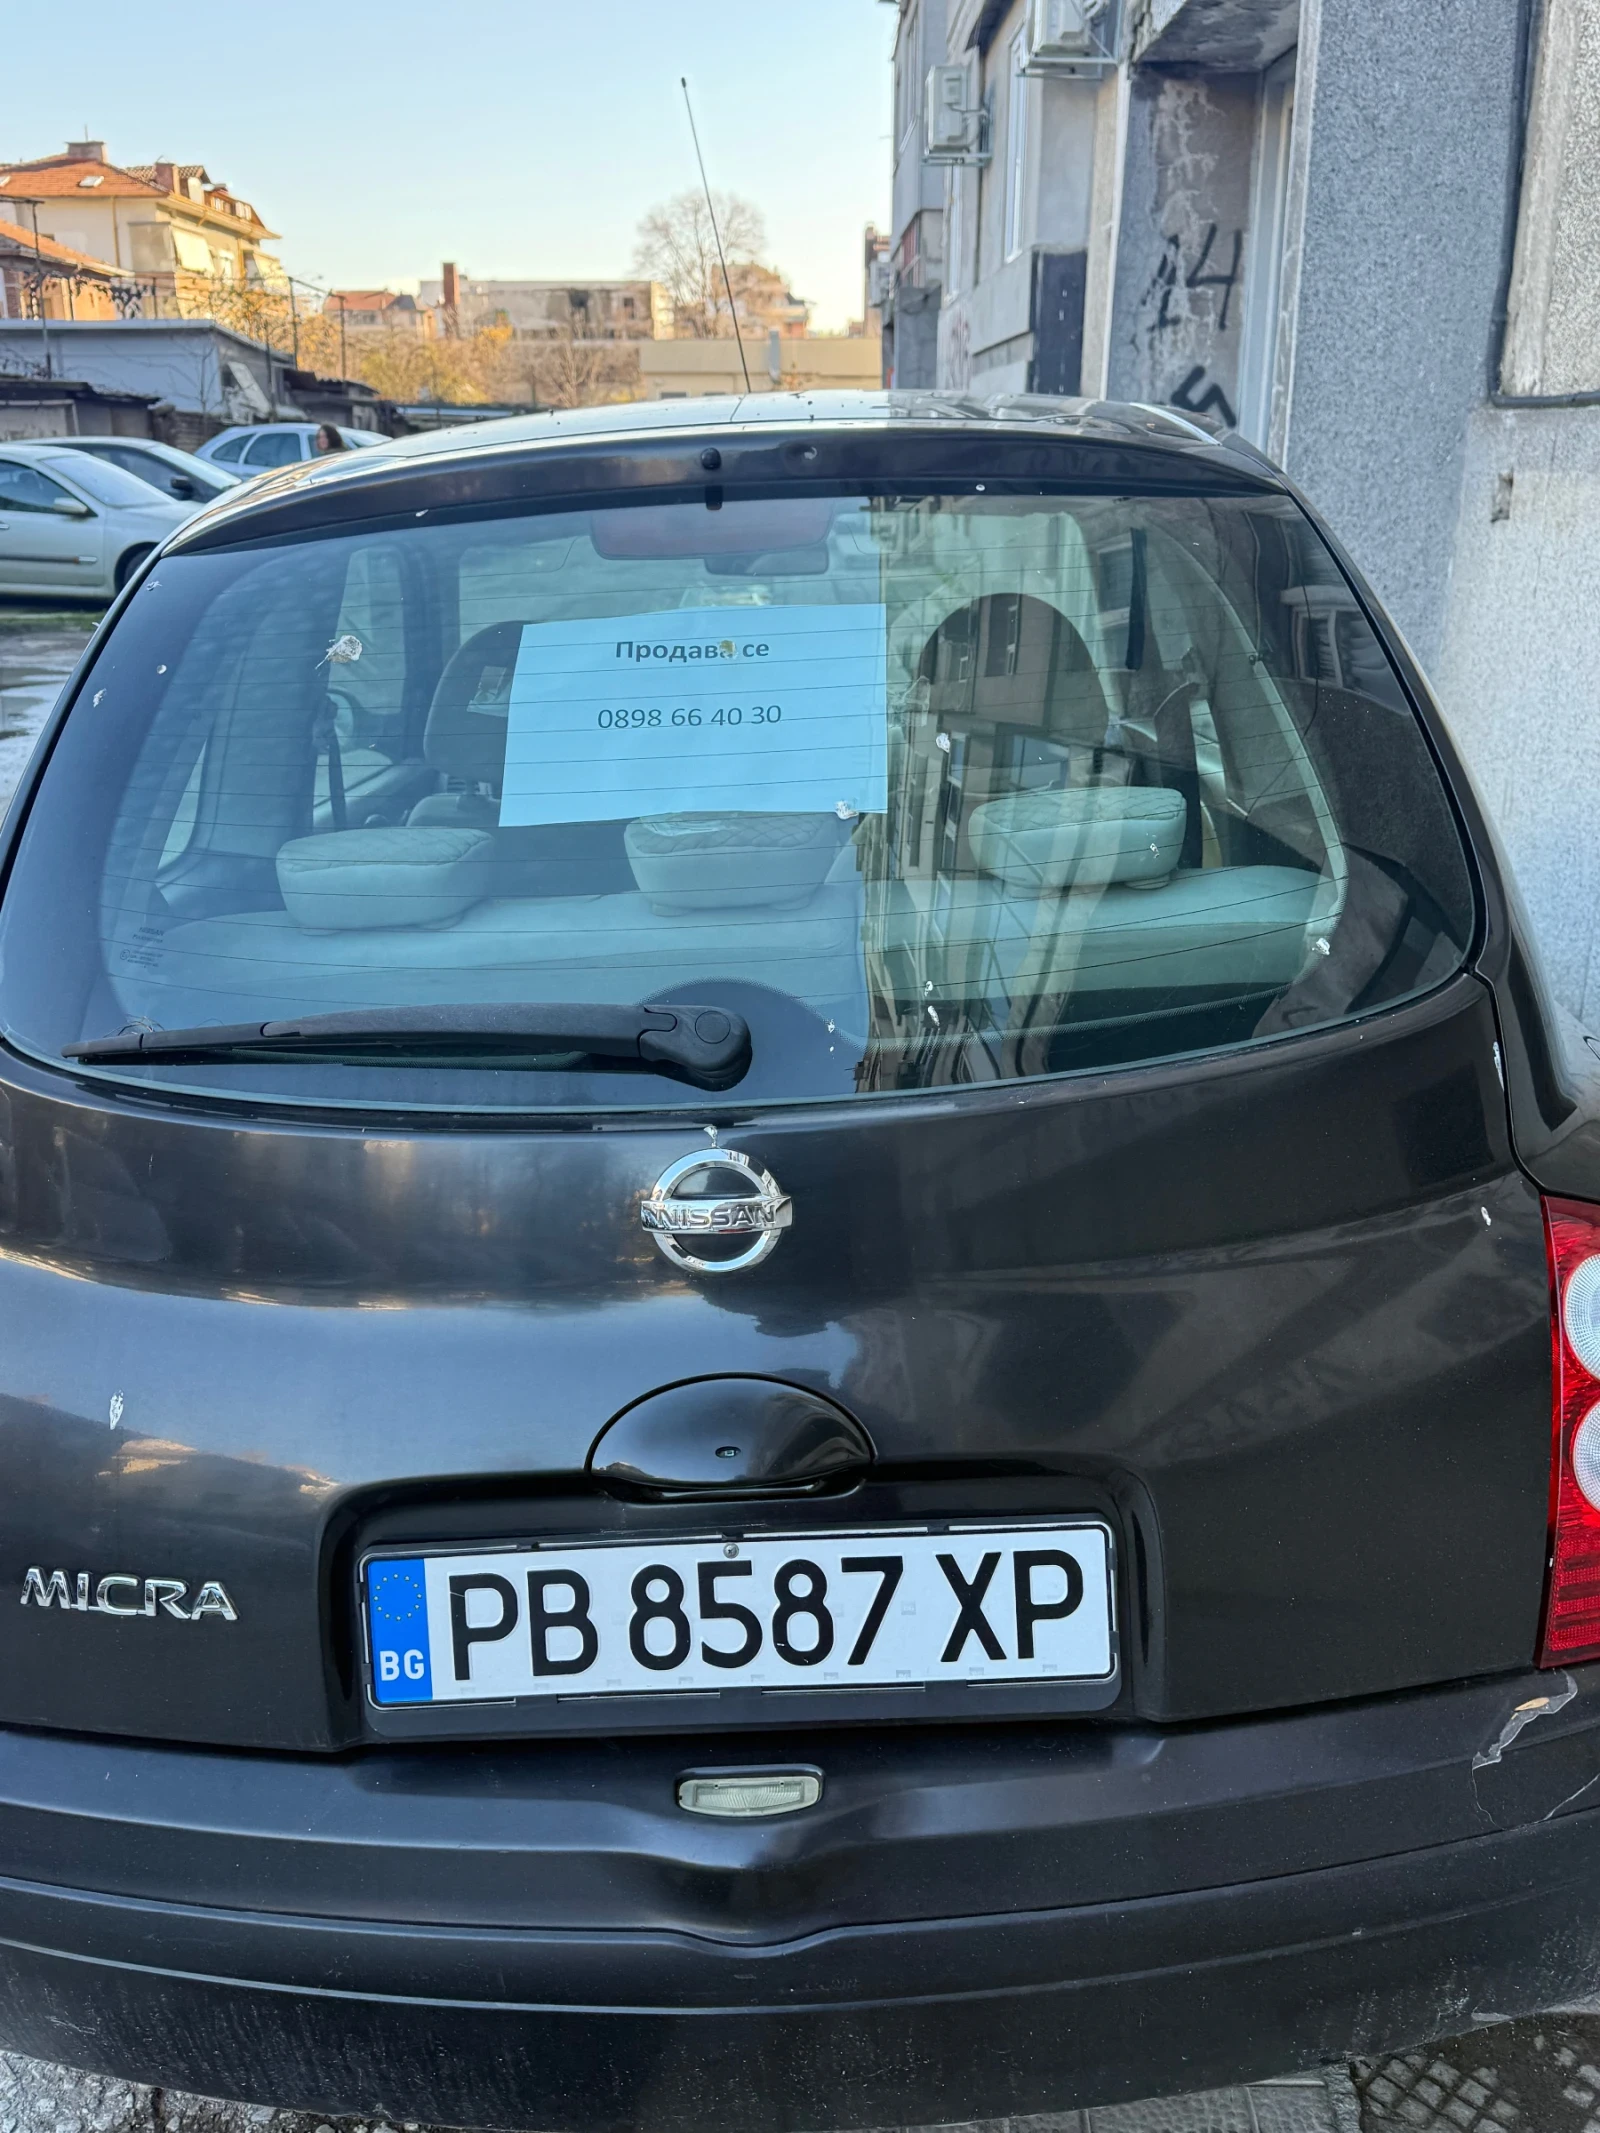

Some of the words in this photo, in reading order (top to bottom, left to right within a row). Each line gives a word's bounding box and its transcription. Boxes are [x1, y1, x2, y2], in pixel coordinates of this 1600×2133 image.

[742, 642, 770, 658] се
[597, 708, 662, 729] 0898
[671, 708, 702, 727] 66
[710, 707, 743, 726] 40
[751, 705, 782, 724] 30
[656, 1206, 776, 1228] NISSAN
[20, 1567, 239, 1620] MICRA
[448, 1568, 599, 1681] PB
[628, 1555, 904, 1671] 8587
[935, 1548, 1085, 1663] XP
[379, 1650, 425, 1682] BG
